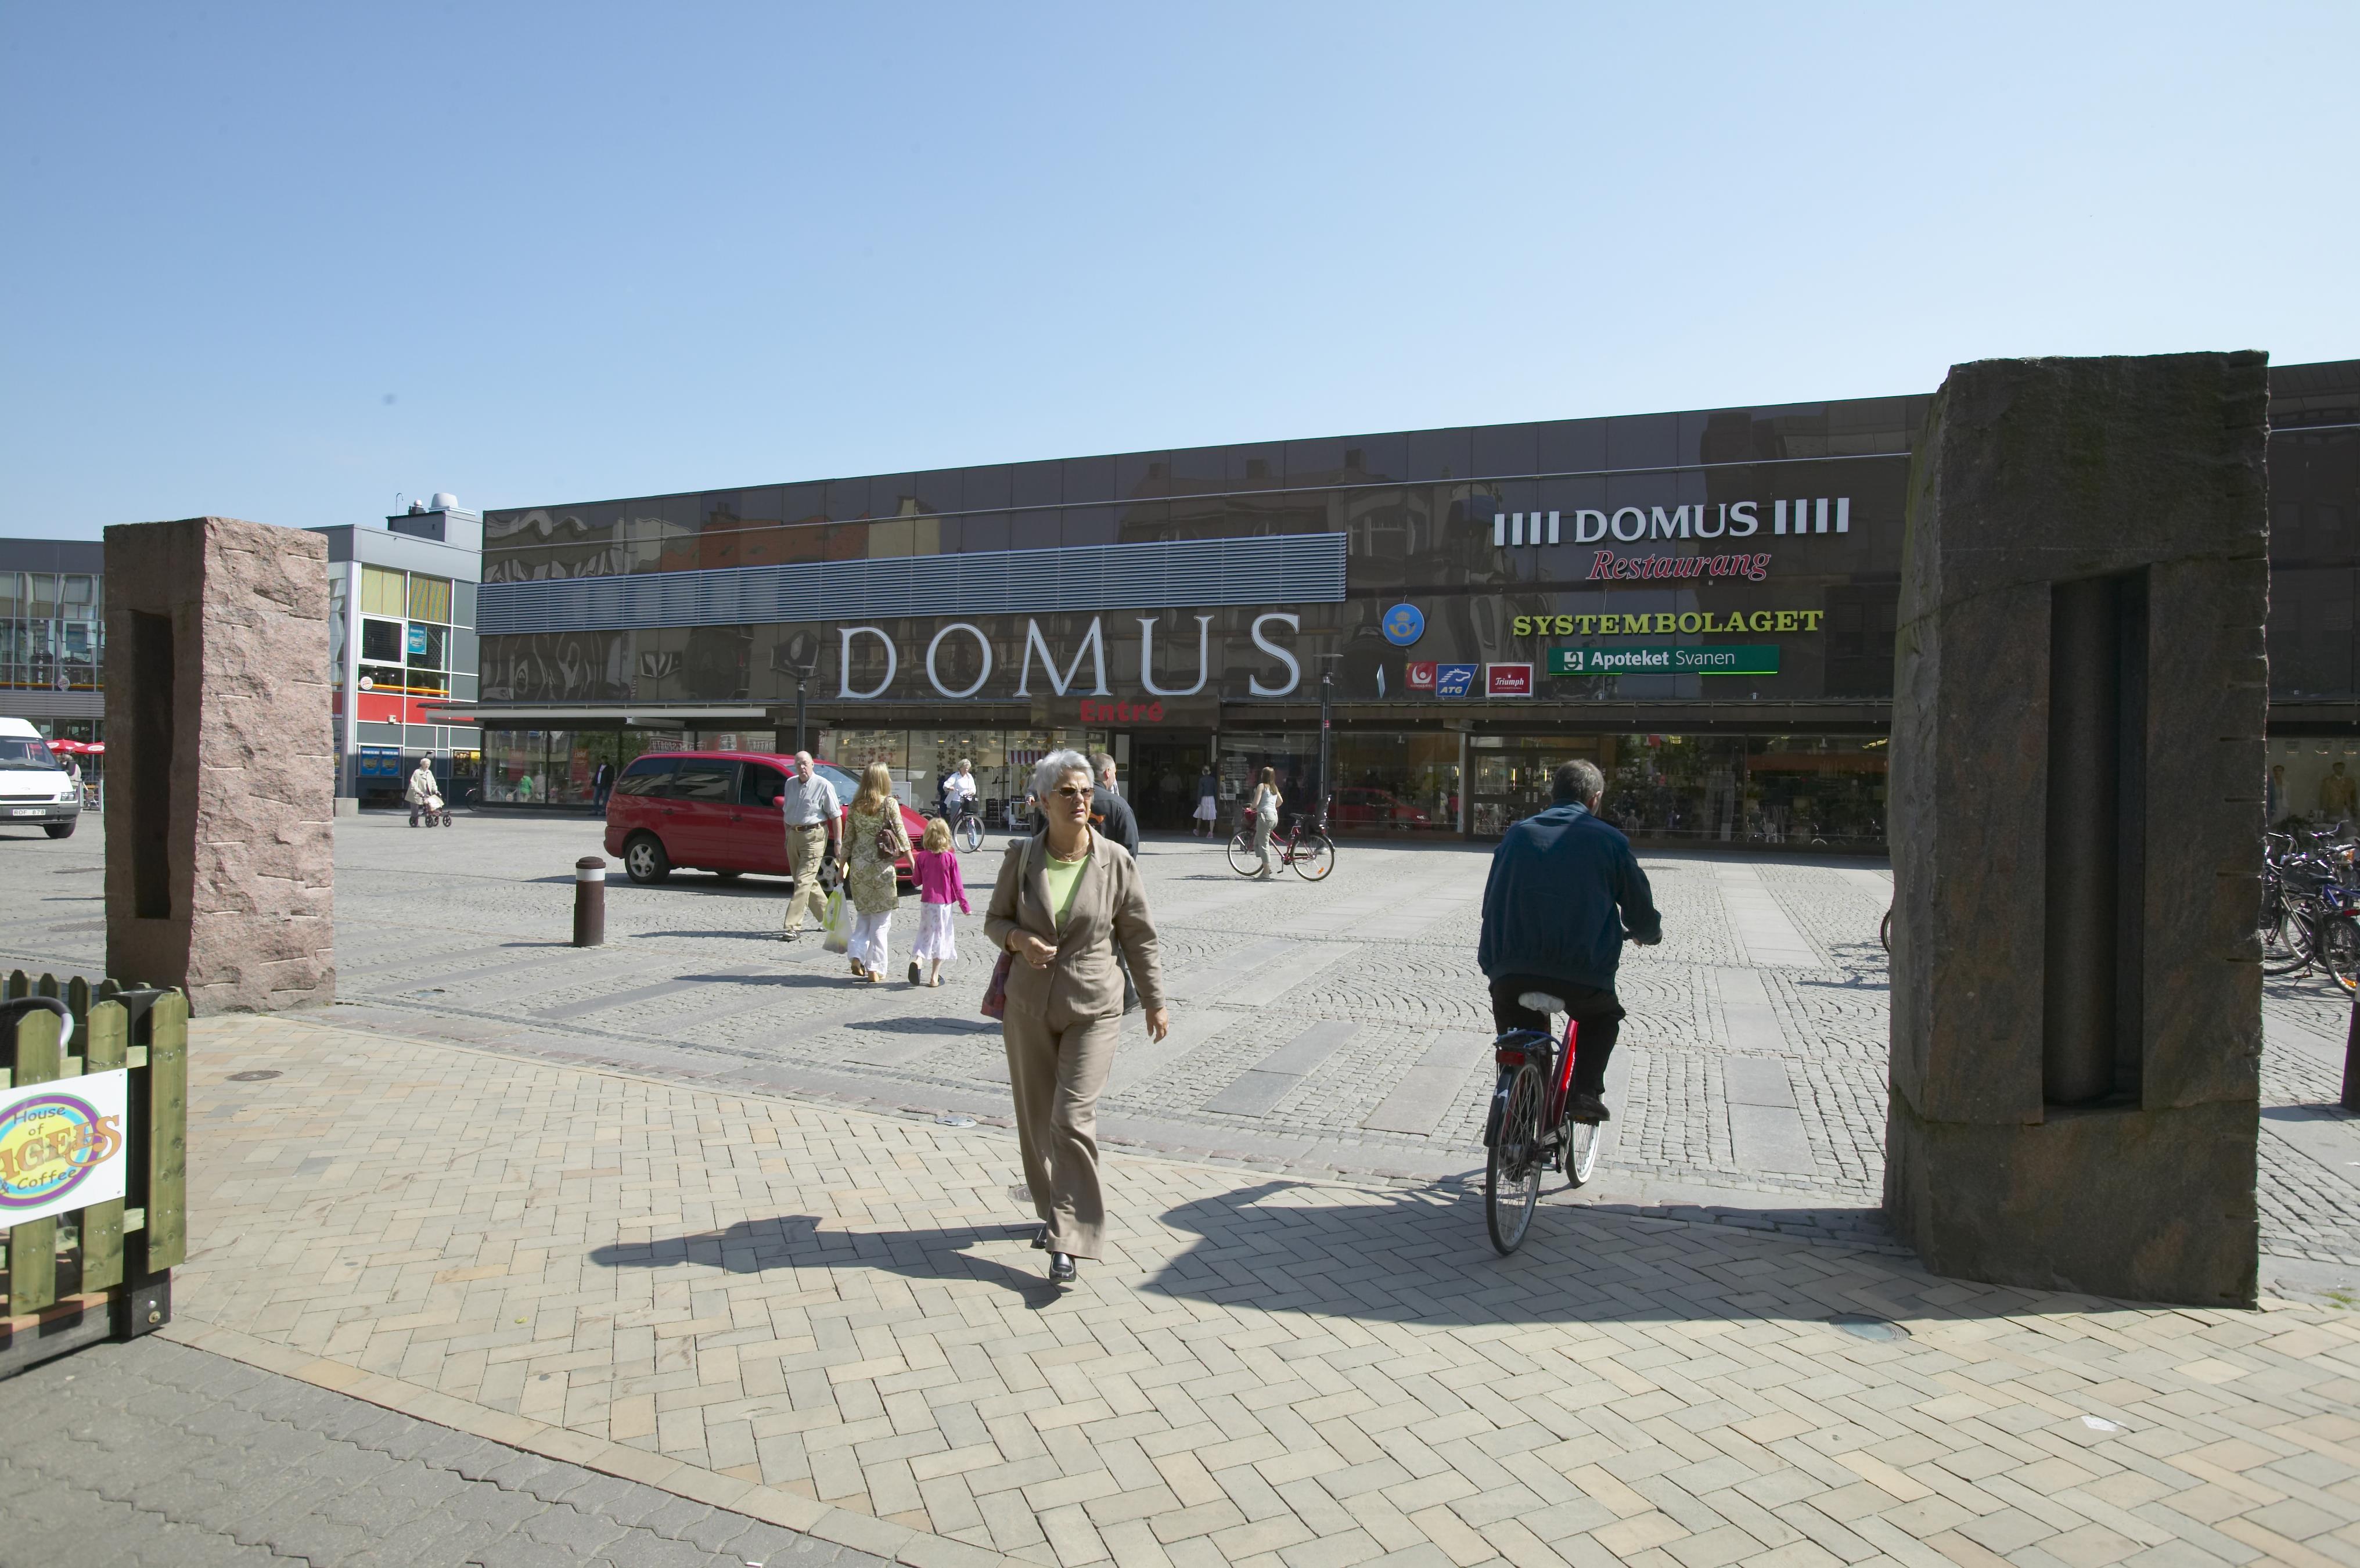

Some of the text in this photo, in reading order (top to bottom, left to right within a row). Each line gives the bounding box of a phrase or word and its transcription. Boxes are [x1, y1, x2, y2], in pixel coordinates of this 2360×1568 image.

[1574, 501, 1758, 543] DOMUS
[1585, 550, 1772, 581] Restaurang
[1513, 610, 1824, 636] SYSTEMBOLAGET
[836, 613, 1301, 699] DOMUS
[1591, 649, 1735, 670] Apoteket Svanen
[1495, 677, 1524, 687] Triumph
[1080, 699, 1164, 722] Entré
[13, 1106, 66, 1124] House
[28, 1123, 44, 1136] of
[17, 1168, 77, 1191] Coffee
